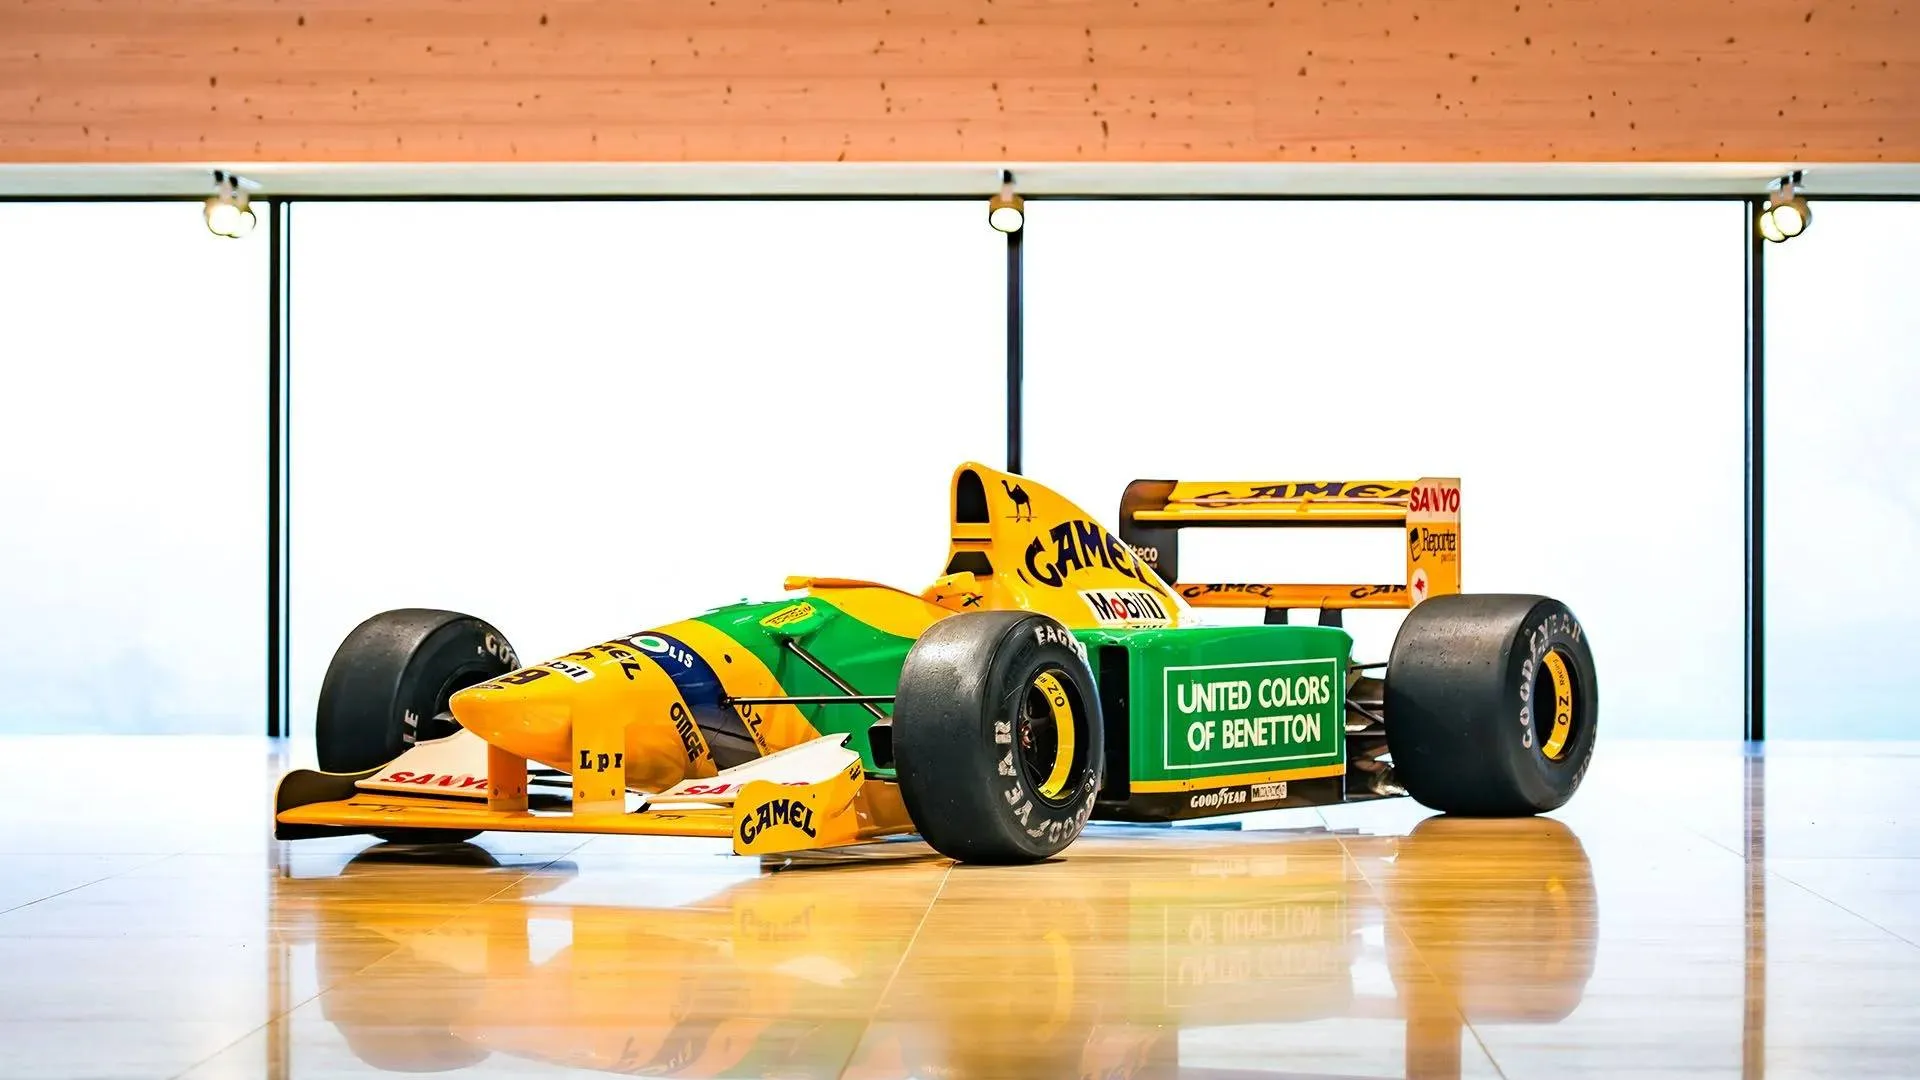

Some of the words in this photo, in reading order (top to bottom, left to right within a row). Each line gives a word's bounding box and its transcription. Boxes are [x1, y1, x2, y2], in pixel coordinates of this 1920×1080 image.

[1409, 486, 1461, 513] SANYO
[1018, 520, 1168, 597] CAMEL
[1183, 583, 1273, 599] CAMEL
[1177, 680, 1251, 714] UNITED
[1258, 674, 1330, 709] COLORS
[1187, 720, 1216, 752] OF
[1222, 712, 1322, 750] BENETTON
[1190, 787, 1248, 810] GOODYEAR
[740, 798, 817, 845] CAMEL
